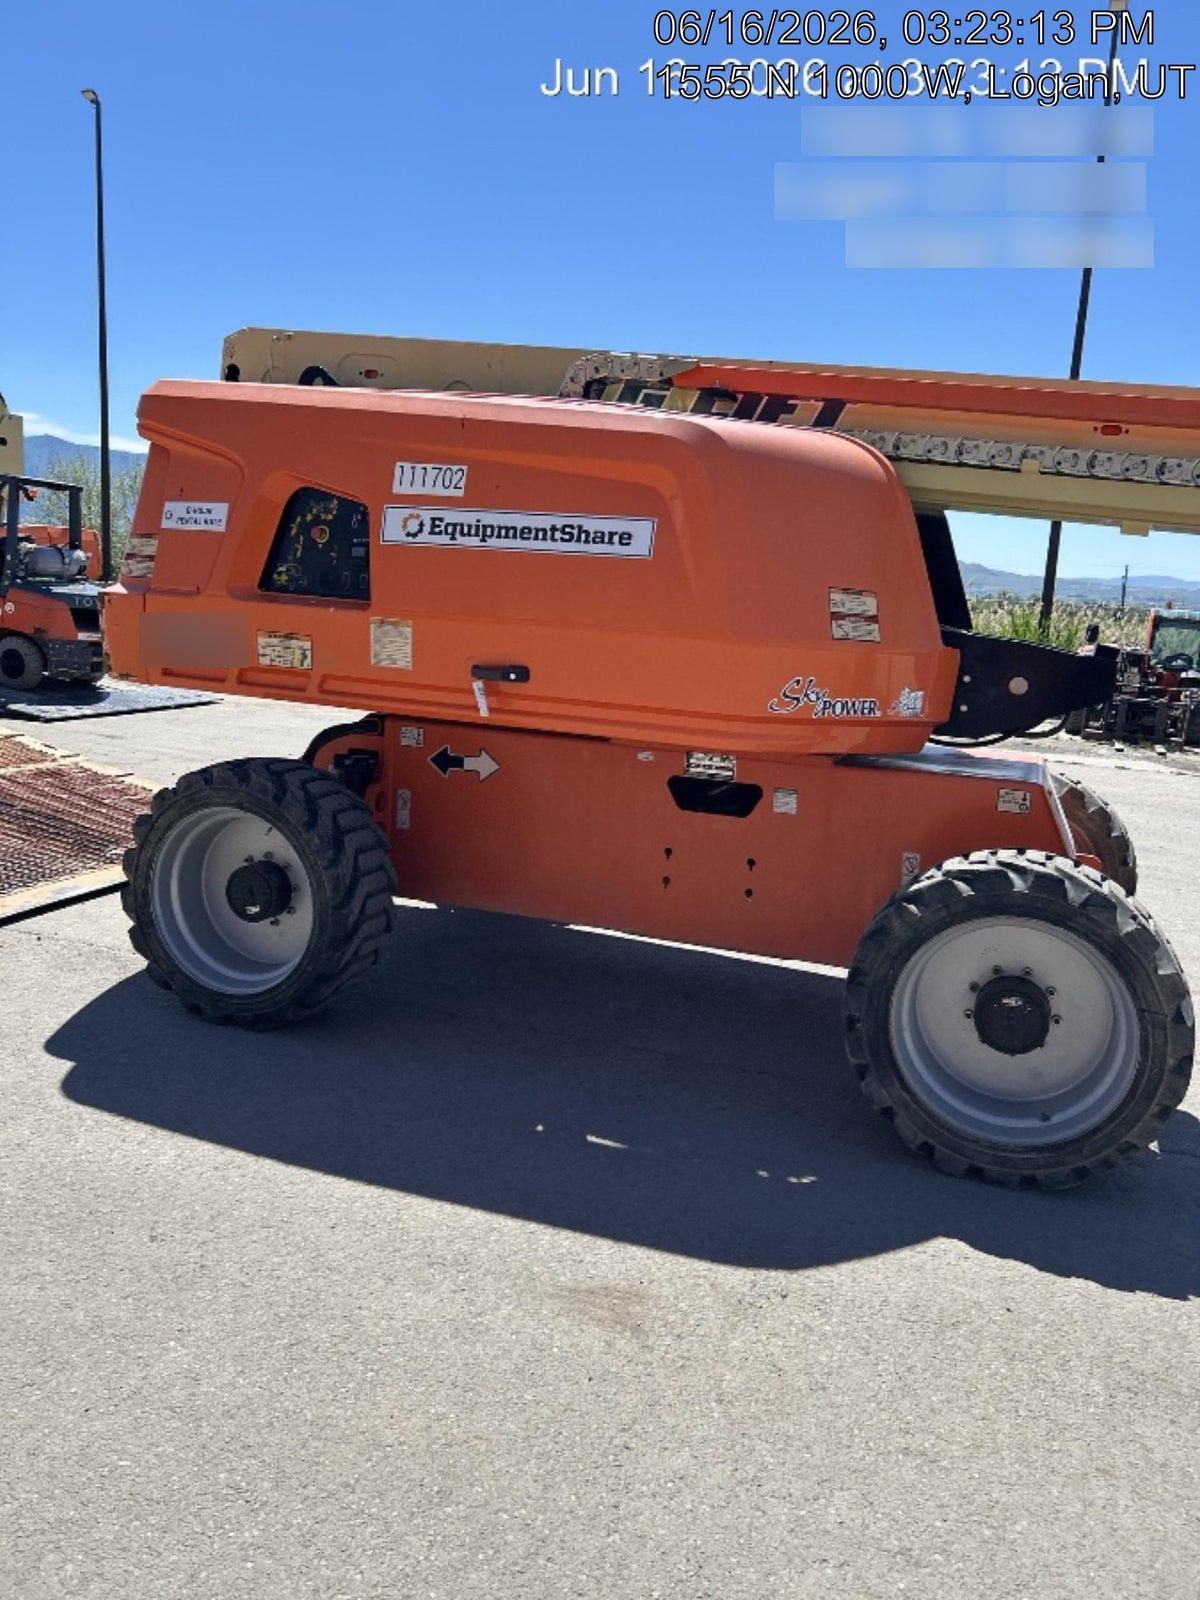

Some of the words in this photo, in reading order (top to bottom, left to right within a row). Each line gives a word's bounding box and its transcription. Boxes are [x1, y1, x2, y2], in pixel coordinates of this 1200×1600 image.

[397, 465, 466, 491] 111702
[428, 516, 634, 548] EquipmentShare
[768, 677, 829, 718] Sky
[822, 699, 879, 718] POWER
